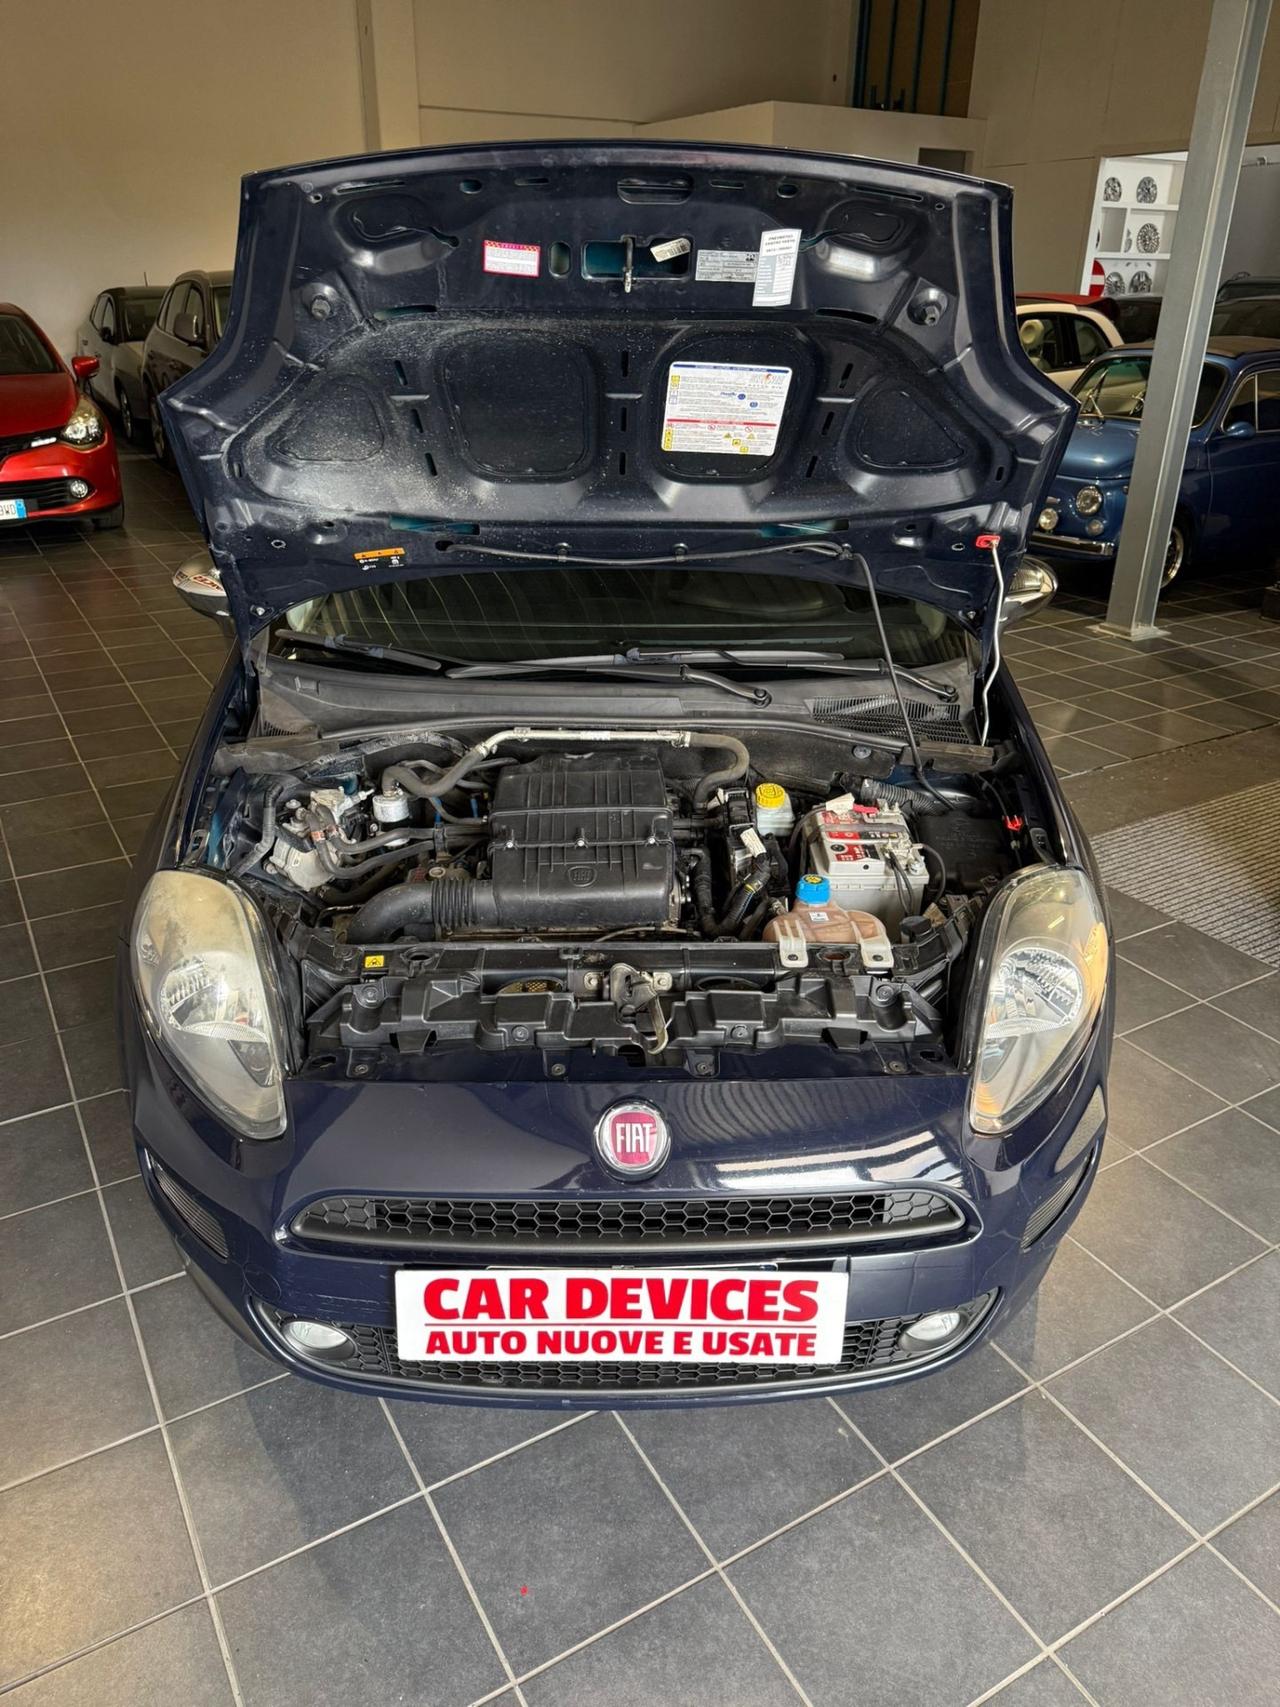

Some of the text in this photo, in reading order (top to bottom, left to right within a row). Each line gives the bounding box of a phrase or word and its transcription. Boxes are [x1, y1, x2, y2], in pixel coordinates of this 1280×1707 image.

[615, 1122, 653, 1153] FIAT
[423, 1277, 819, 1322] CAR DEVICES
[426, 1330, 817, 1357] AUTO NUOVE E USATE
